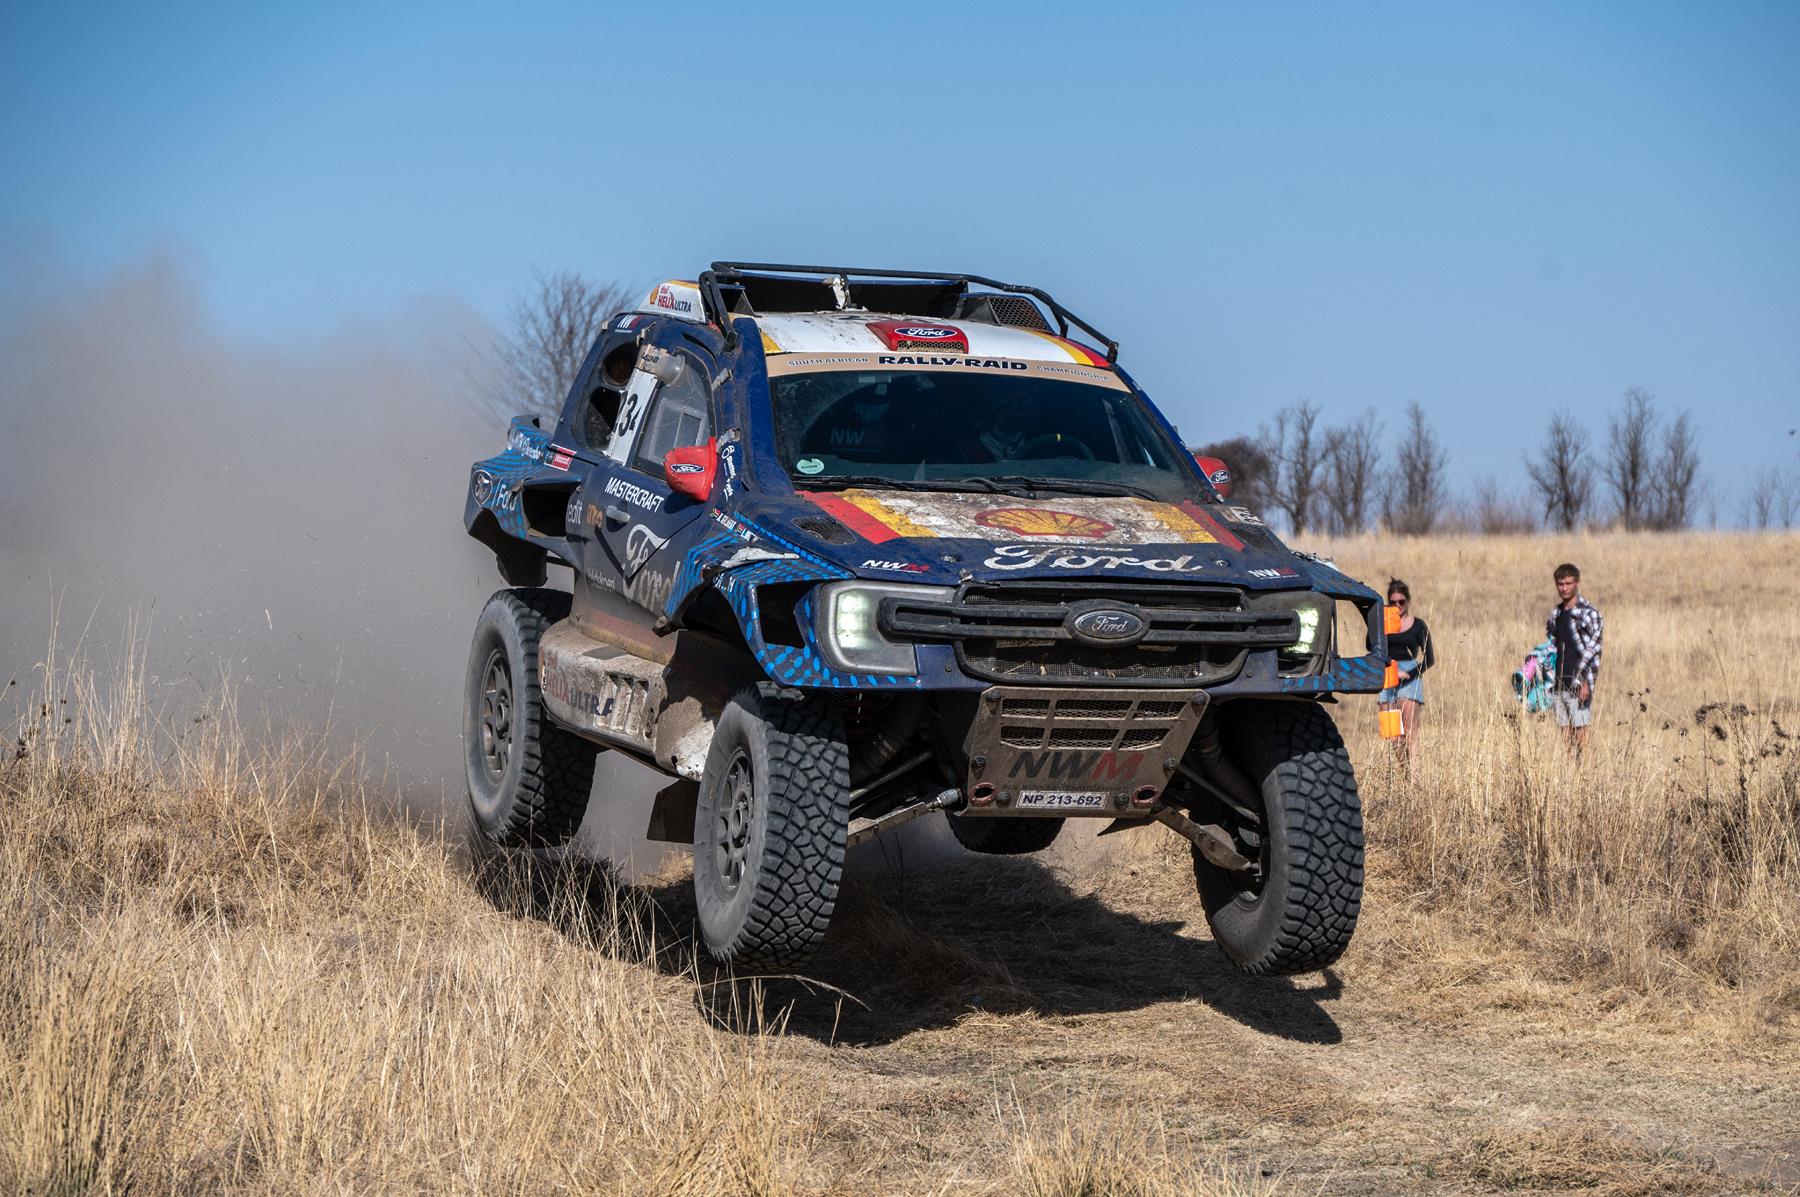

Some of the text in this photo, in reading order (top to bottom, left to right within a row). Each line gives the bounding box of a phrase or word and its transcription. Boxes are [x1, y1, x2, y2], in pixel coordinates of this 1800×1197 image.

[907, 328, 945, 337] Ford
[878, 356, 1028, 371] RALLY-RAID
[604, 477, 665, 513] MASTERCRAFT
[861, 559, 930, 572] NWM
[983, 544, 1203, 572] Ford
[1091, 615, 1128, 633] Ford
[1007, 751, 1145, 779] NWM
[1022, 794, 1102, 806] NP 213-692
